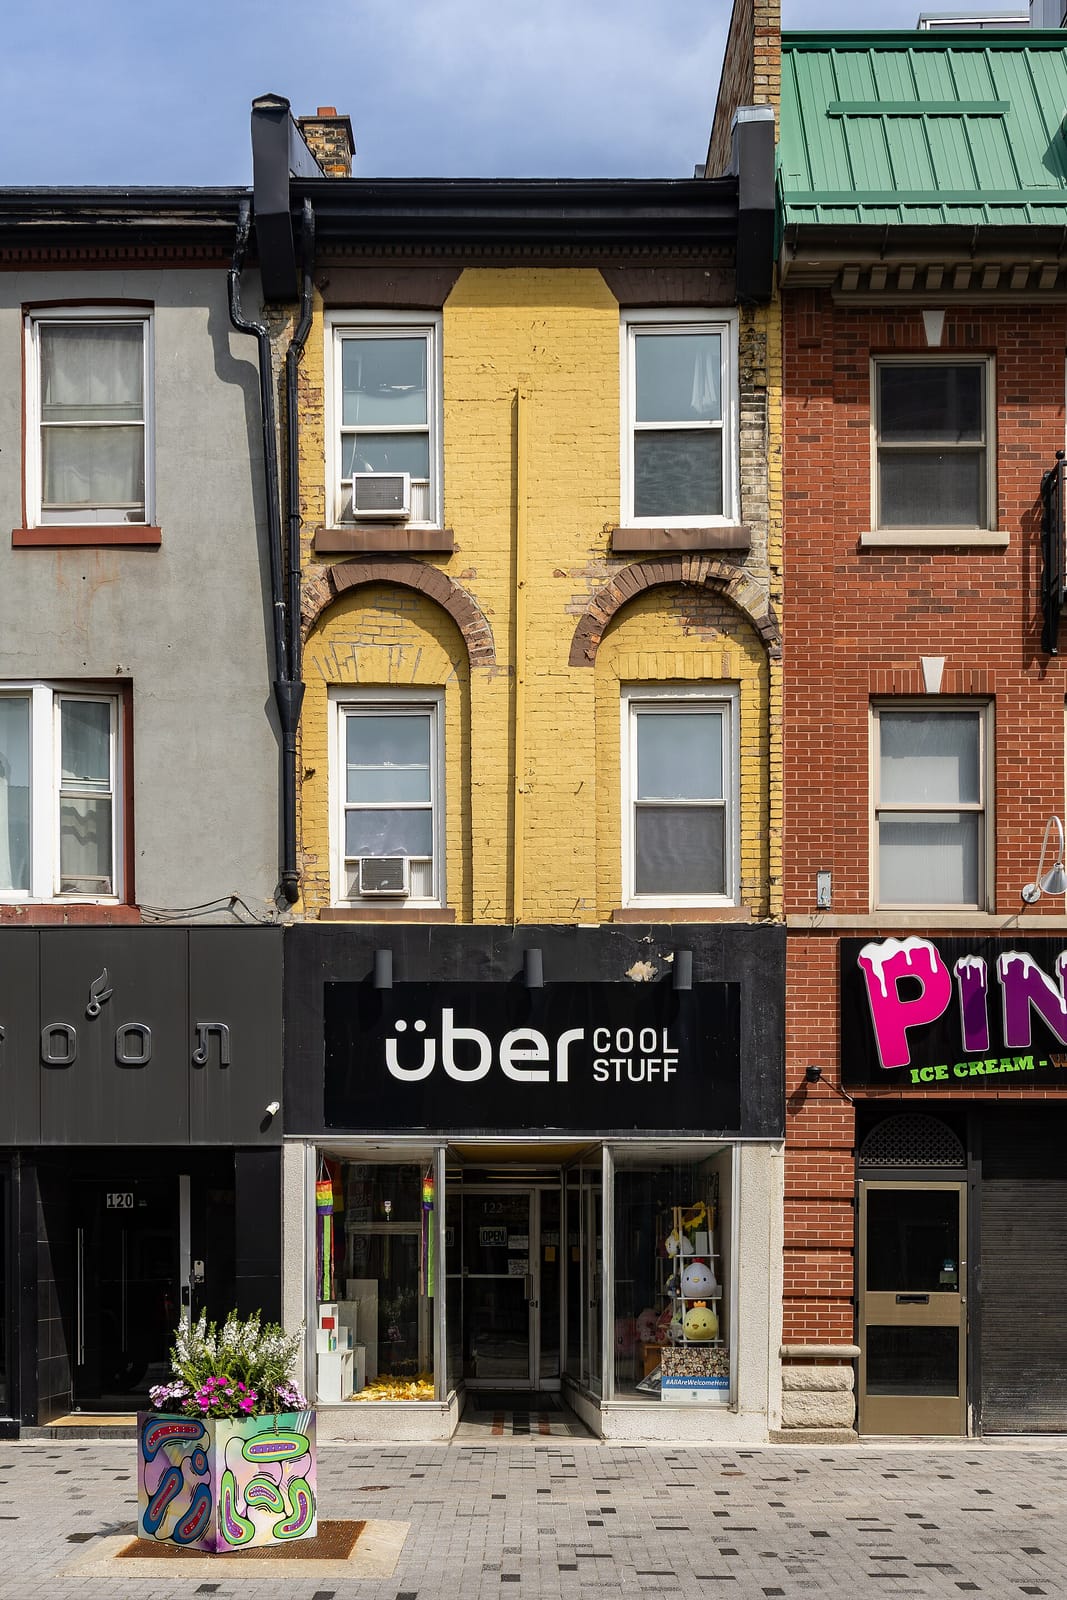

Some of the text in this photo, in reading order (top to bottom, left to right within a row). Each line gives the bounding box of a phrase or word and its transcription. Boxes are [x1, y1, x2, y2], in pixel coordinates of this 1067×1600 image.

[385, 1008, 584, 1082] über
[593, 1027, 679, 1053] COOL
[593, 1058, 679, 1082] STUFF
[910, 1065, 949, 1083] ICE
[953, 1056, 1035, 1077] CREAM
[108, 1194, 132, 1207] 120
[482, 1231, 505, 1241] OPEN
